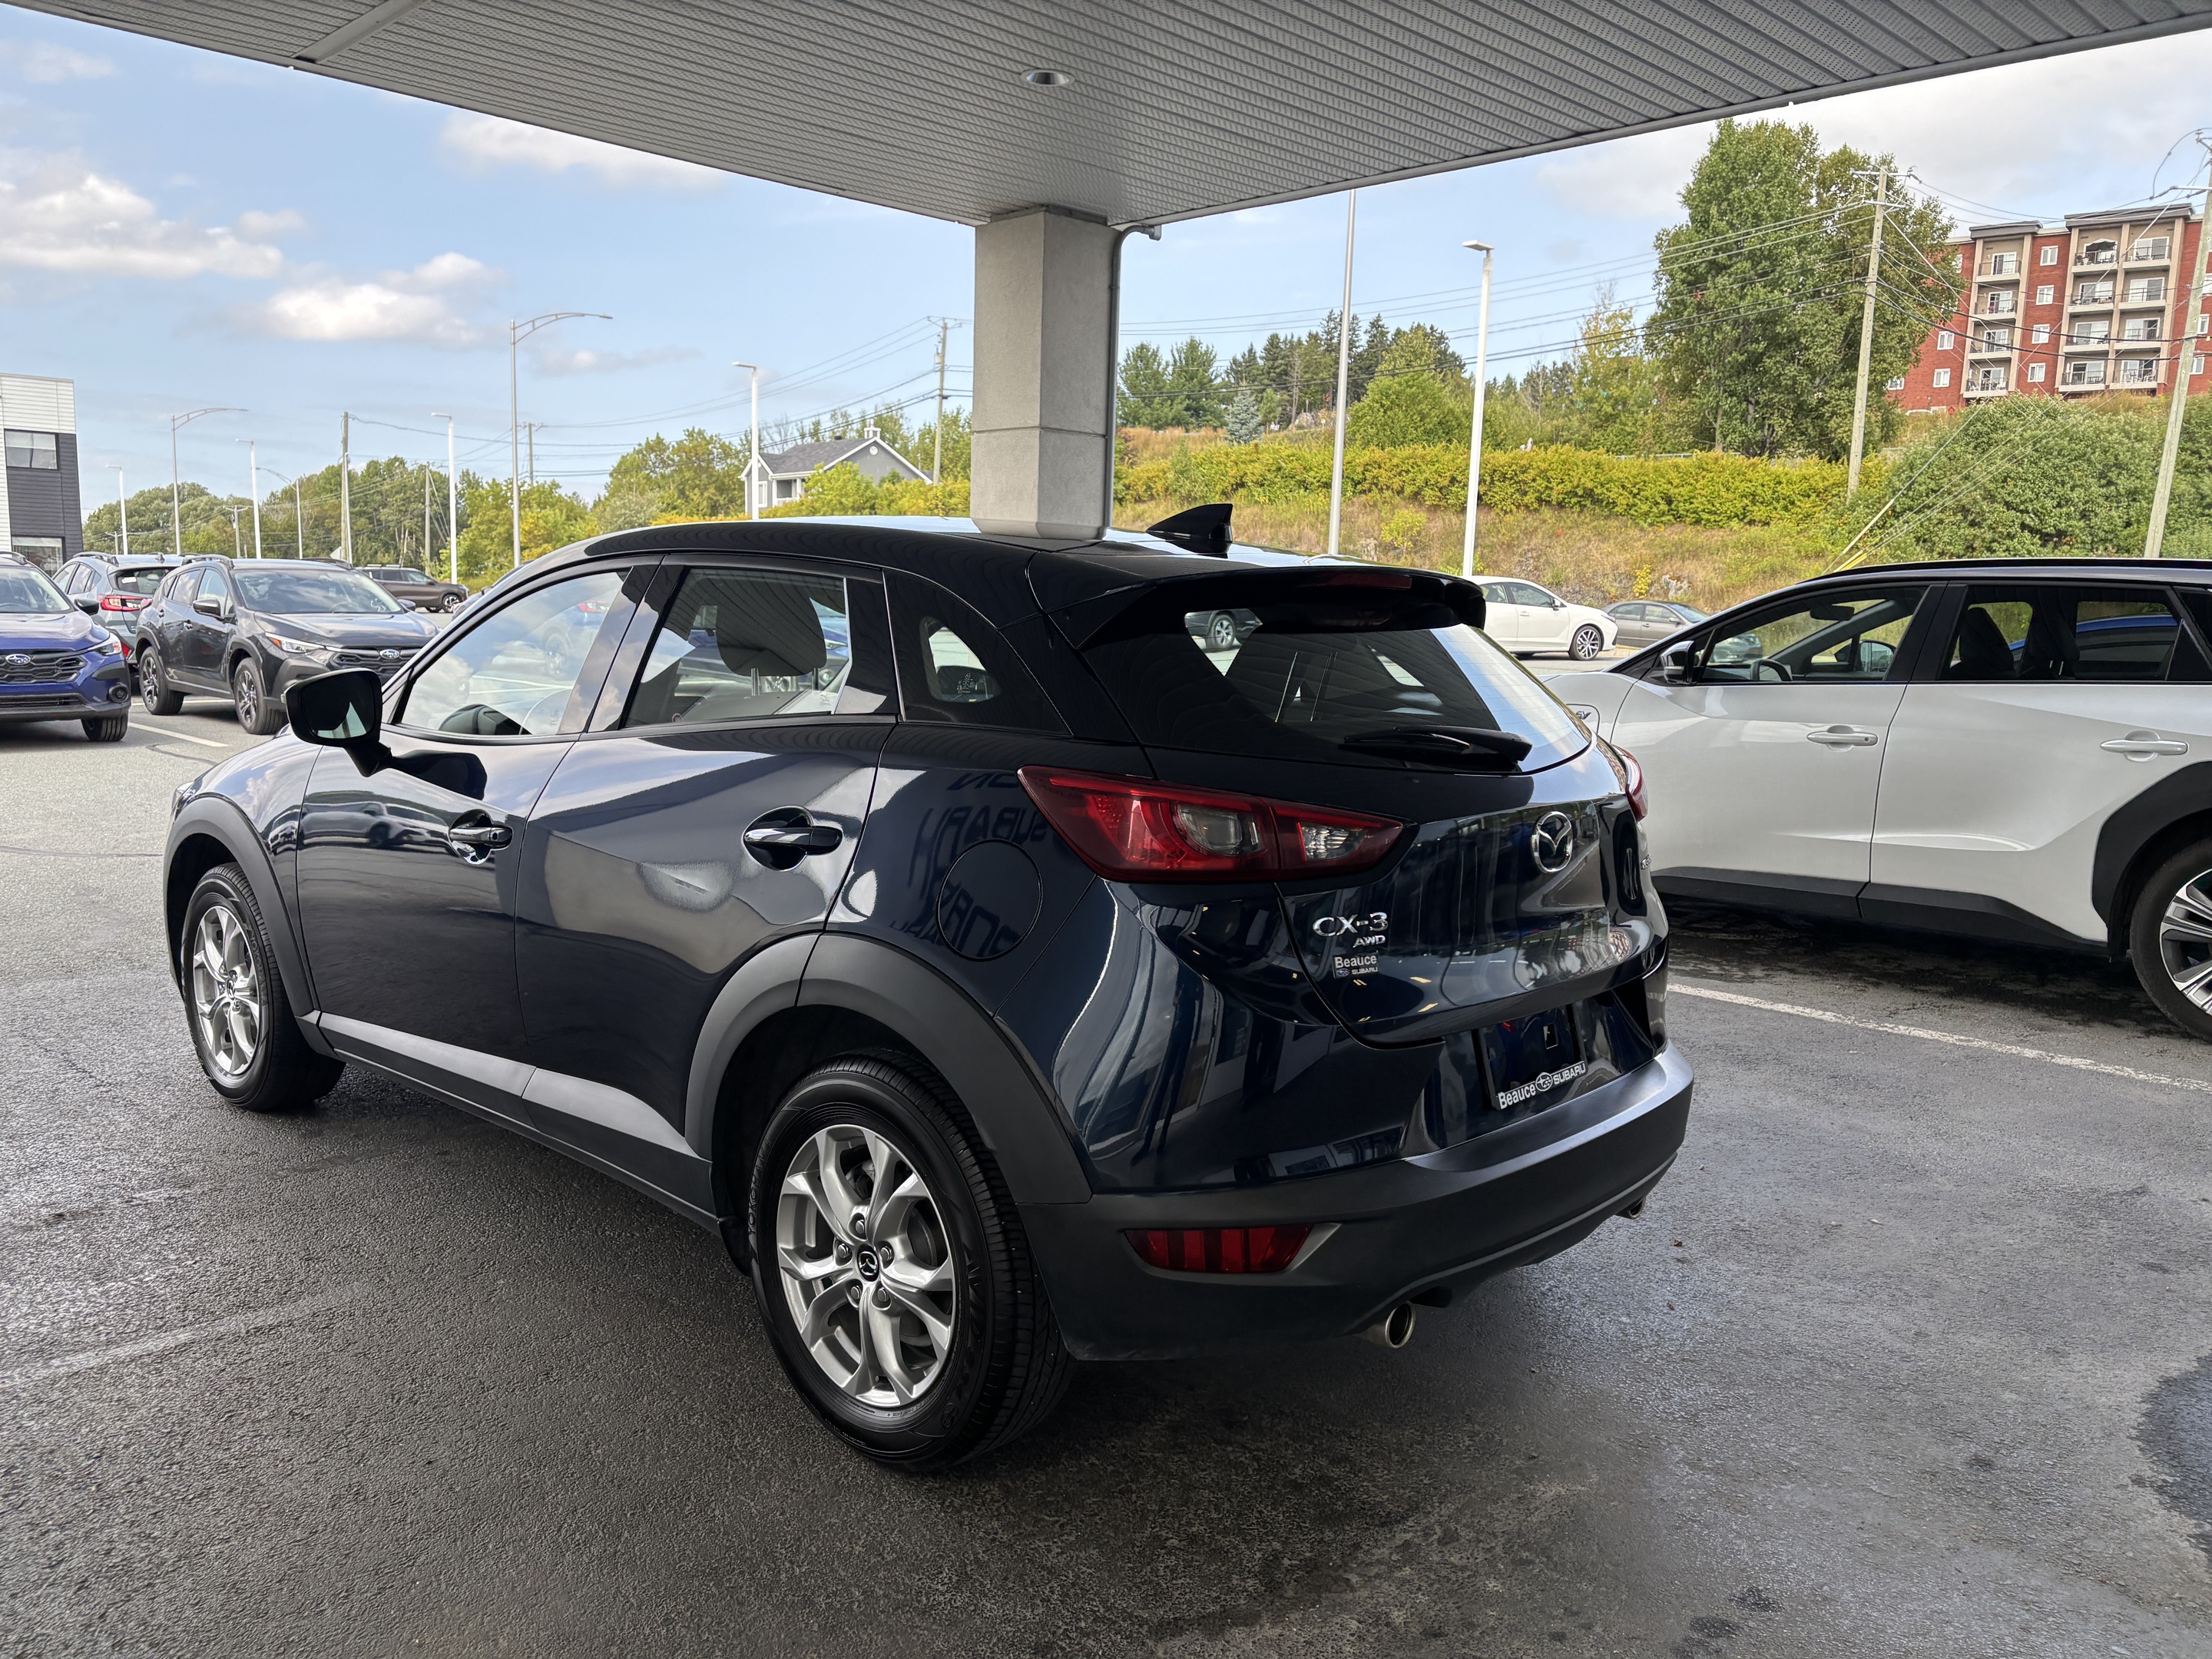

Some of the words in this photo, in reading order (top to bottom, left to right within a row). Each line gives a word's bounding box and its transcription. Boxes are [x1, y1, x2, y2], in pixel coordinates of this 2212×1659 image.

[1313, 912, 1389, 936] CX-3
[1353, 935, 1386, 948] AWD
[1334, 955, 1377, 969] Beauce
[1498, 1084, 1536, 1110] Beauce
[1553, 1062, 1586, 1085] SUBARU
